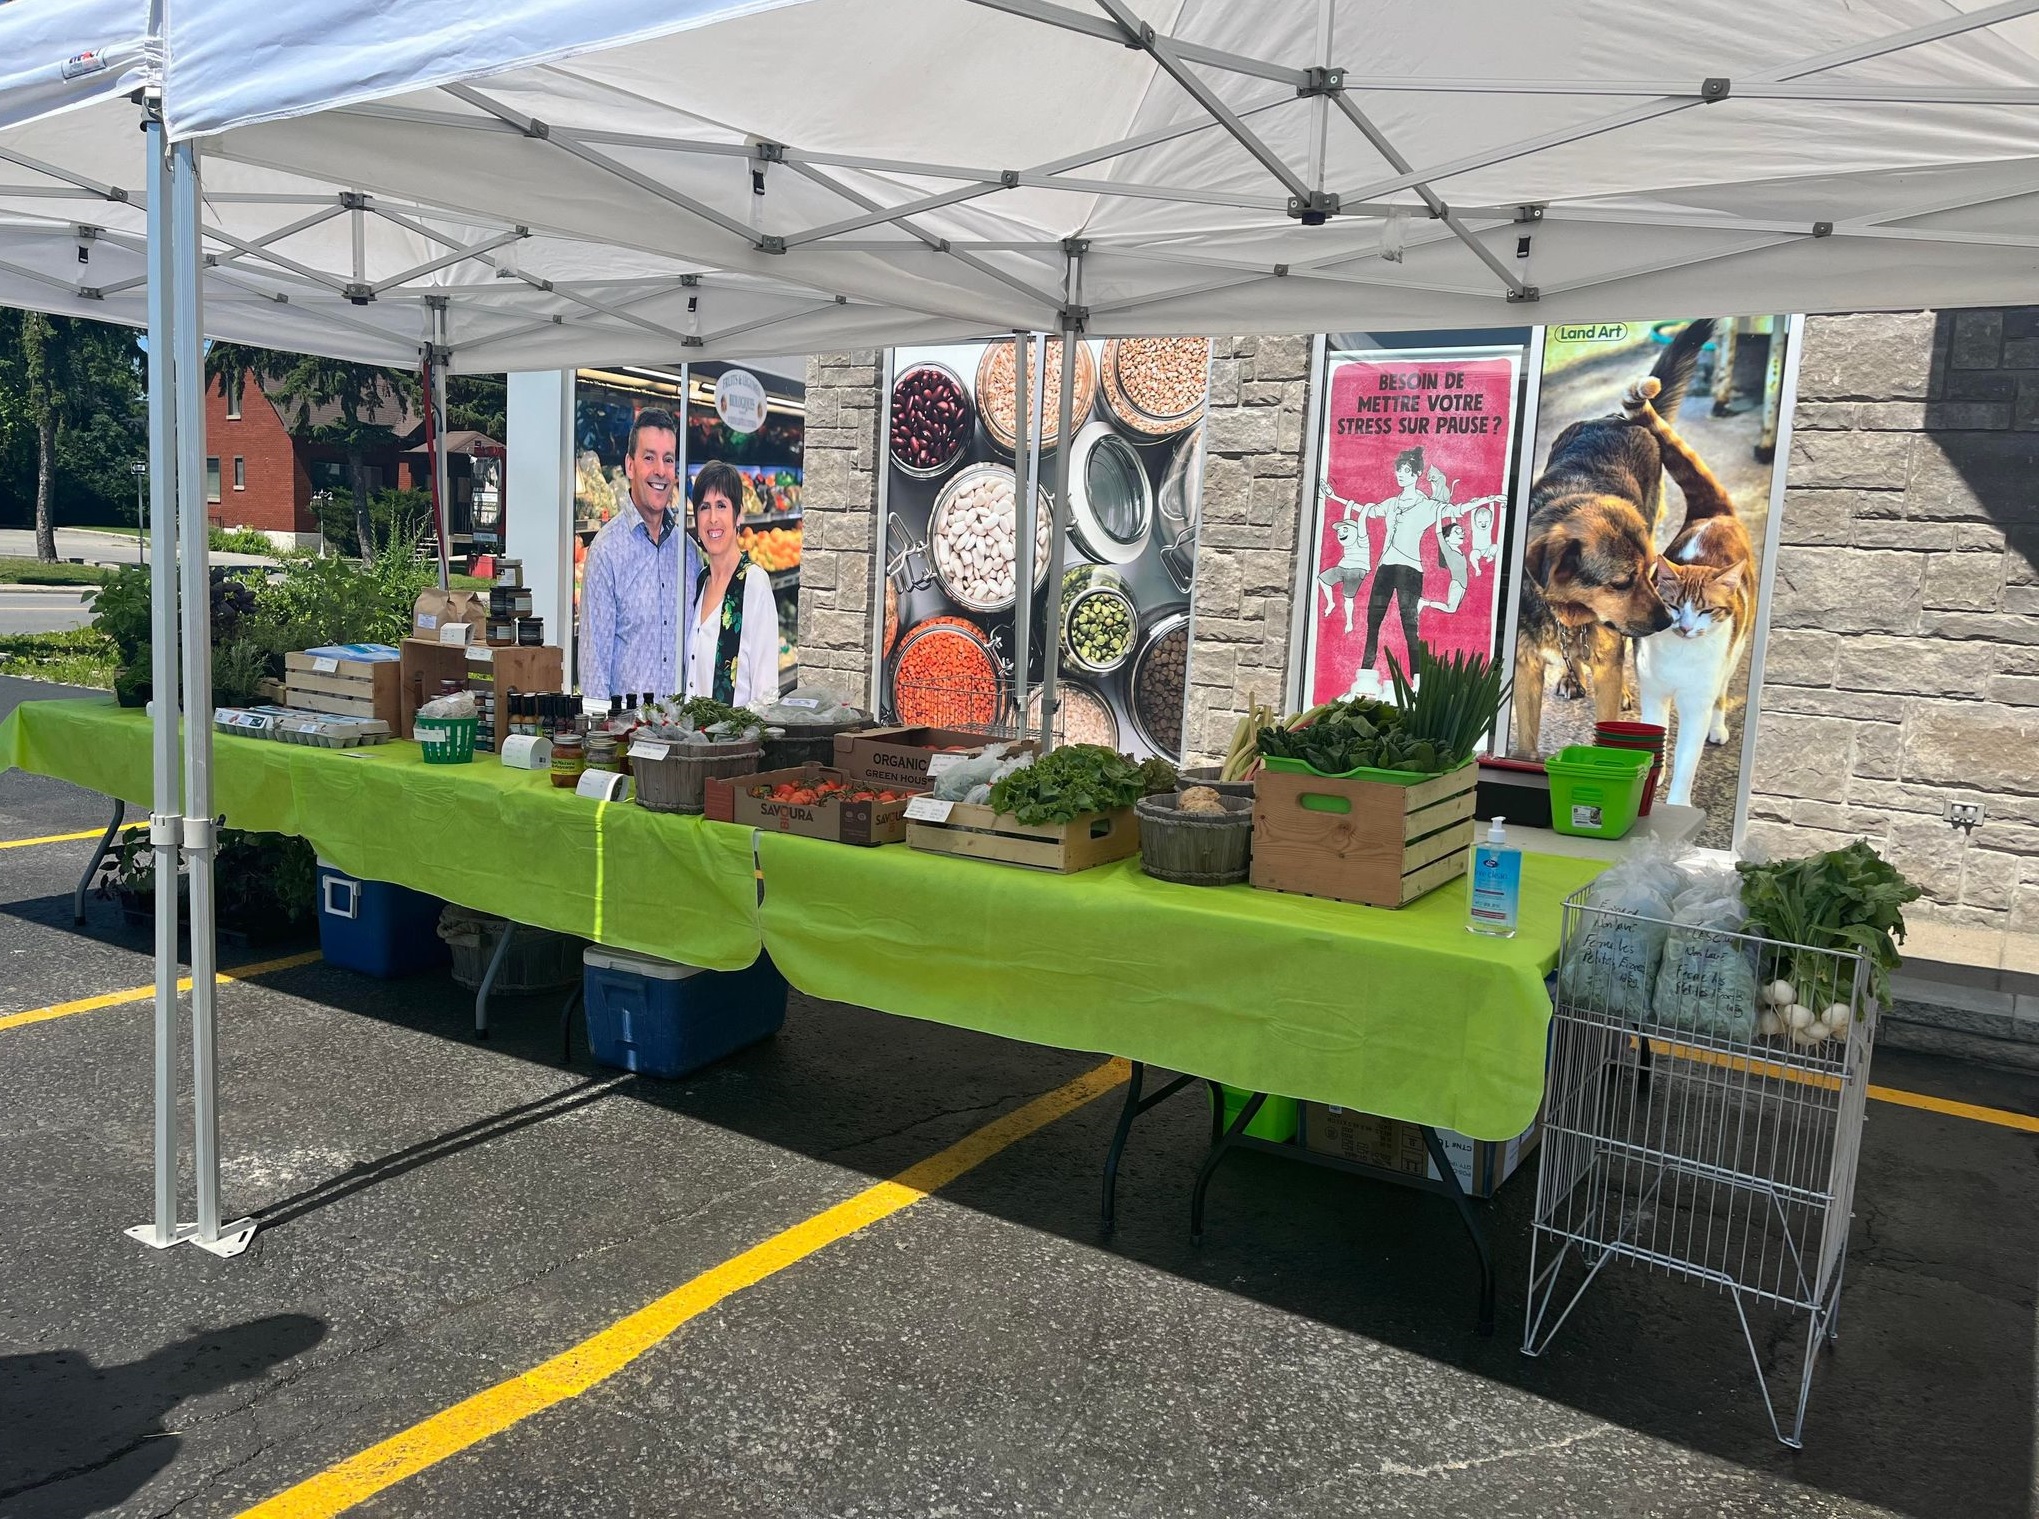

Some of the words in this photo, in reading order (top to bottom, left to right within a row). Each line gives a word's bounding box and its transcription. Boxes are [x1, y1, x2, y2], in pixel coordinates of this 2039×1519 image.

[1560, 326, 1595, 340] Land
[1597, 325, 1623, 339] Art
[1379, 373, 1438, 391] BESOIN
[1445, 372, 1465, 389] DE
[1357, 395, 1420, 413] METTRE
[1427, 394, 1484, 412] VOTRE
[1337, 417, 1392, 435] STRESS
[1398, 416, 1429, 434] SUR
[1436, 416, 1488, 434] PAUSE
[873, 753, 927, 771] ORGANIC
[865, 769, 898, 782] GREEN
[900, 774, 934, 786] HOUS
[760, 803, 814, 822] SAVOURA
